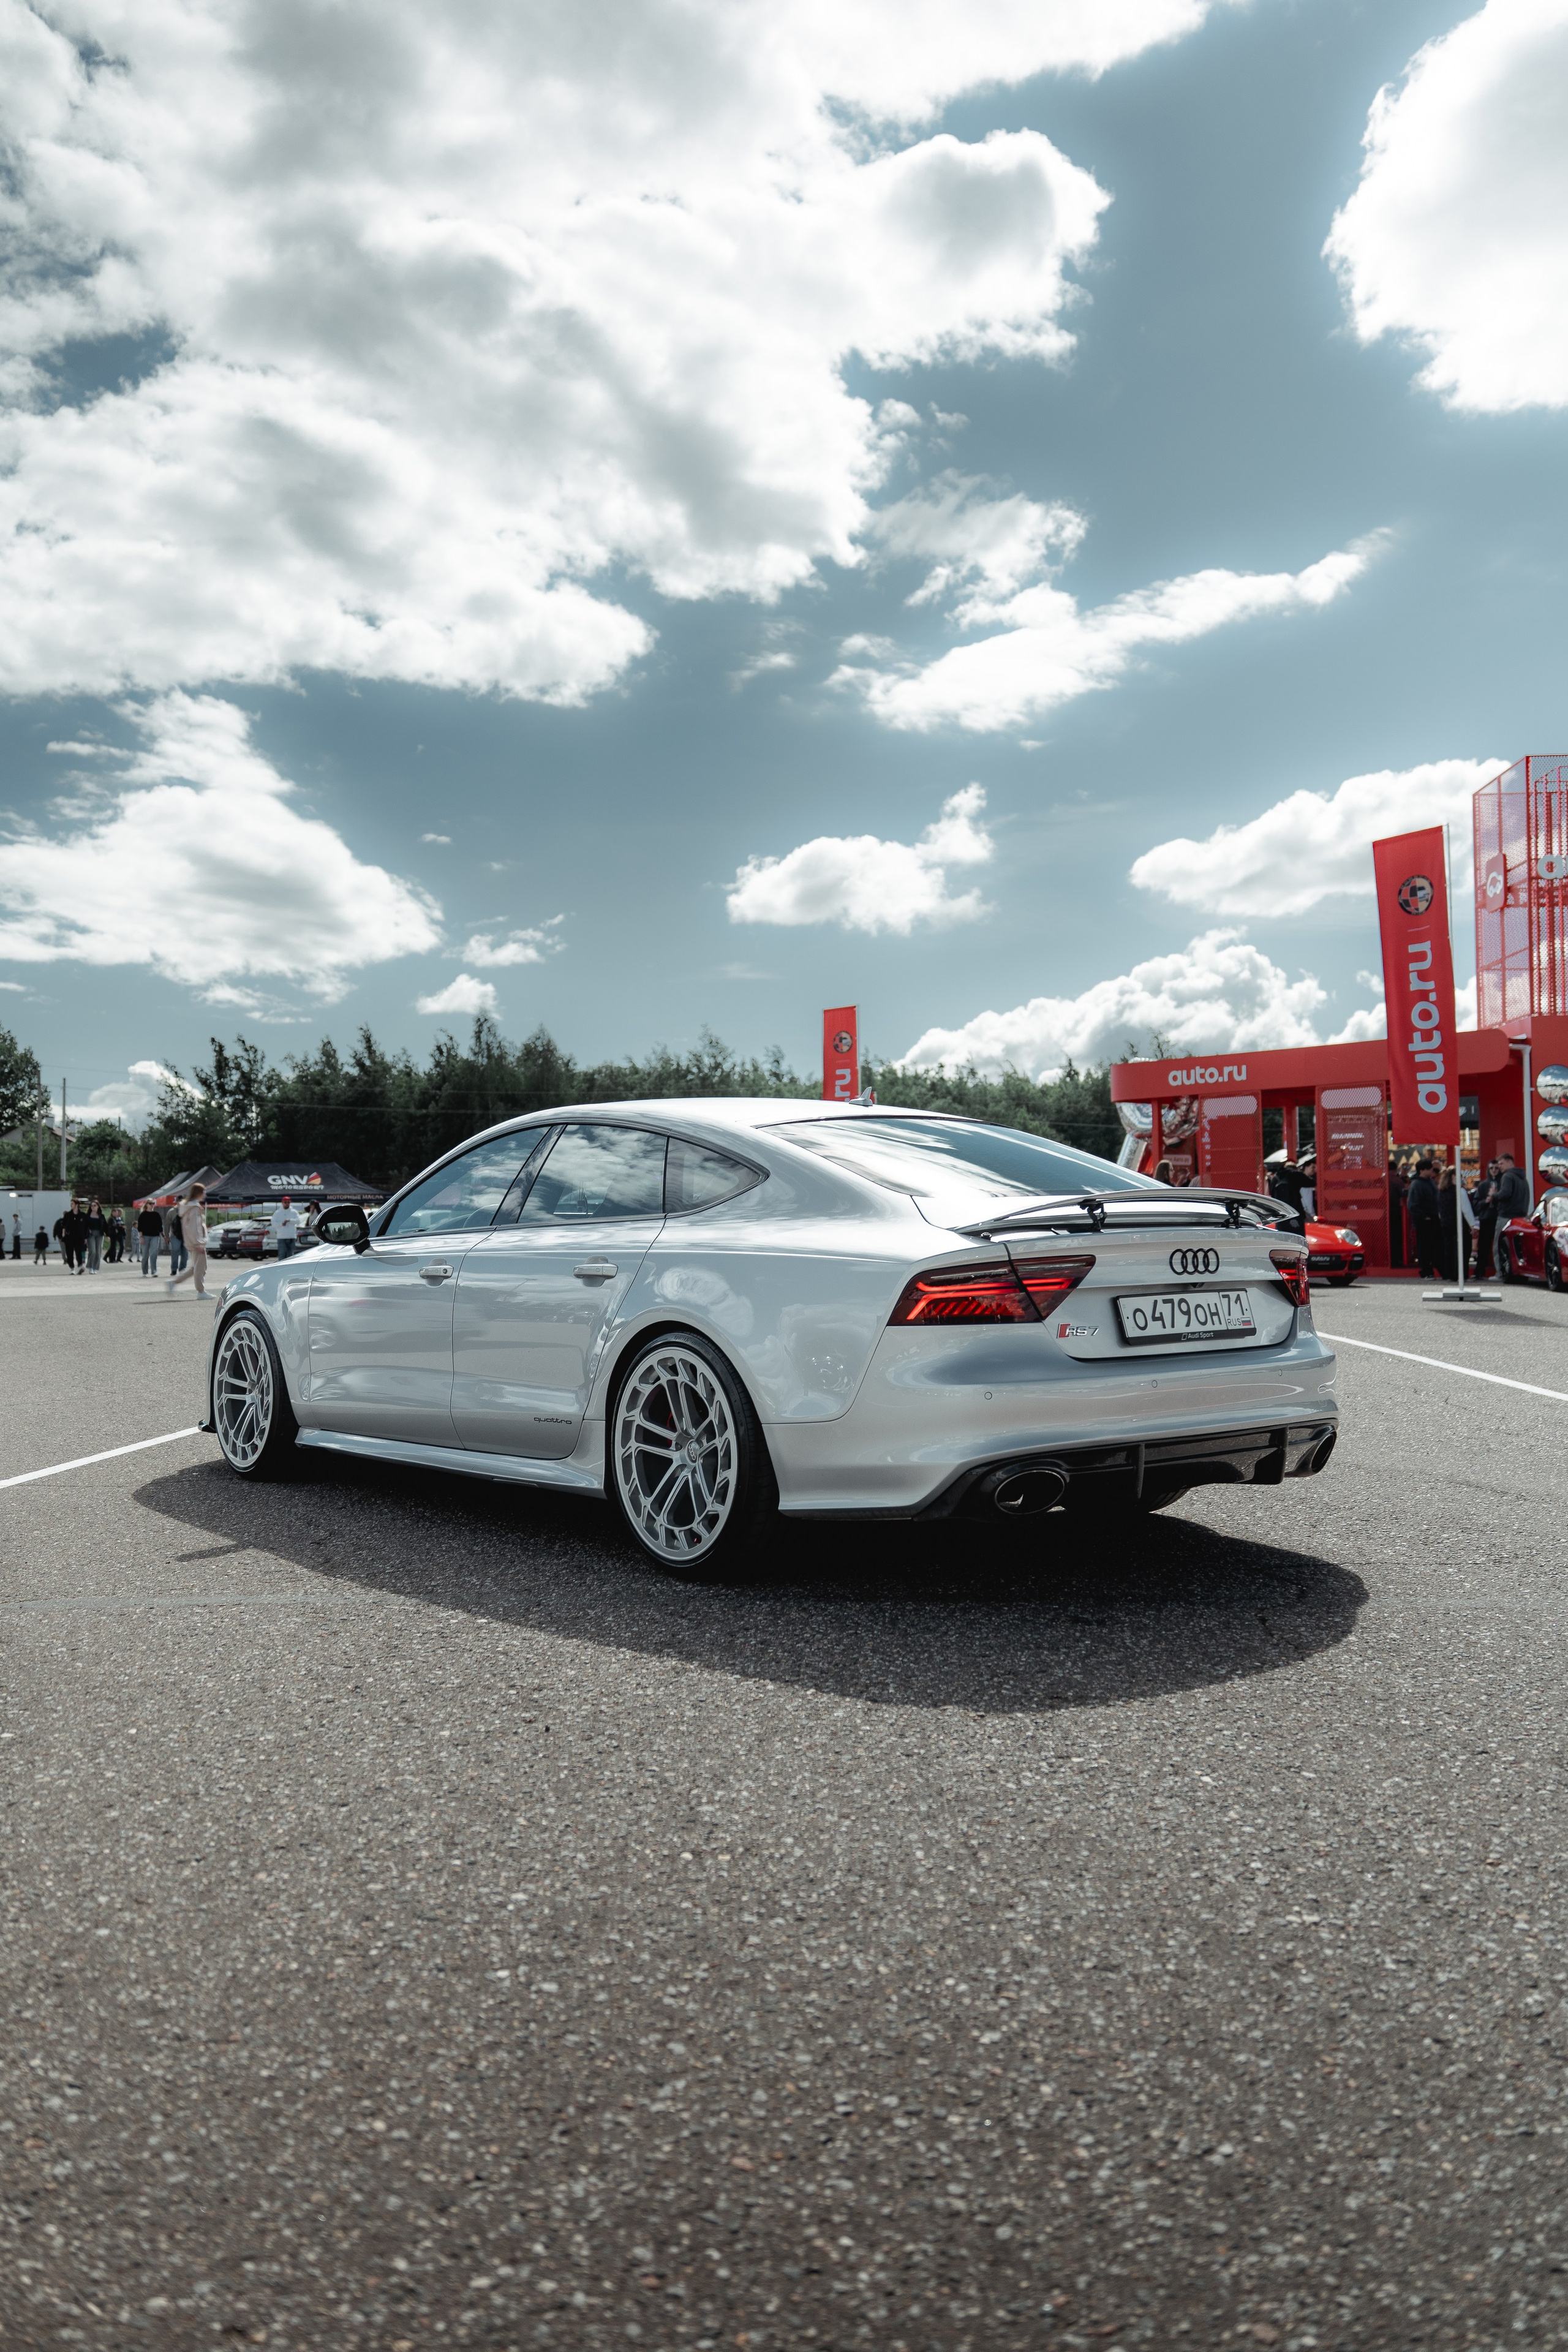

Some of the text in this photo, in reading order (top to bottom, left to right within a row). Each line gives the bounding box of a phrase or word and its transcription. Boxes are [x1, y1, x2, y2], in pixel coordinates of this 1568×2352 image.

[1408, 940, 1447, 1113] auto.ru
[1168, 1065, 1247, 1087] auto.ru
[267, 1174, 309, 1185] GNV
[1221, 1294, 1245, 1316] 71
[1227, 1317, 1242, 1327] RUS
